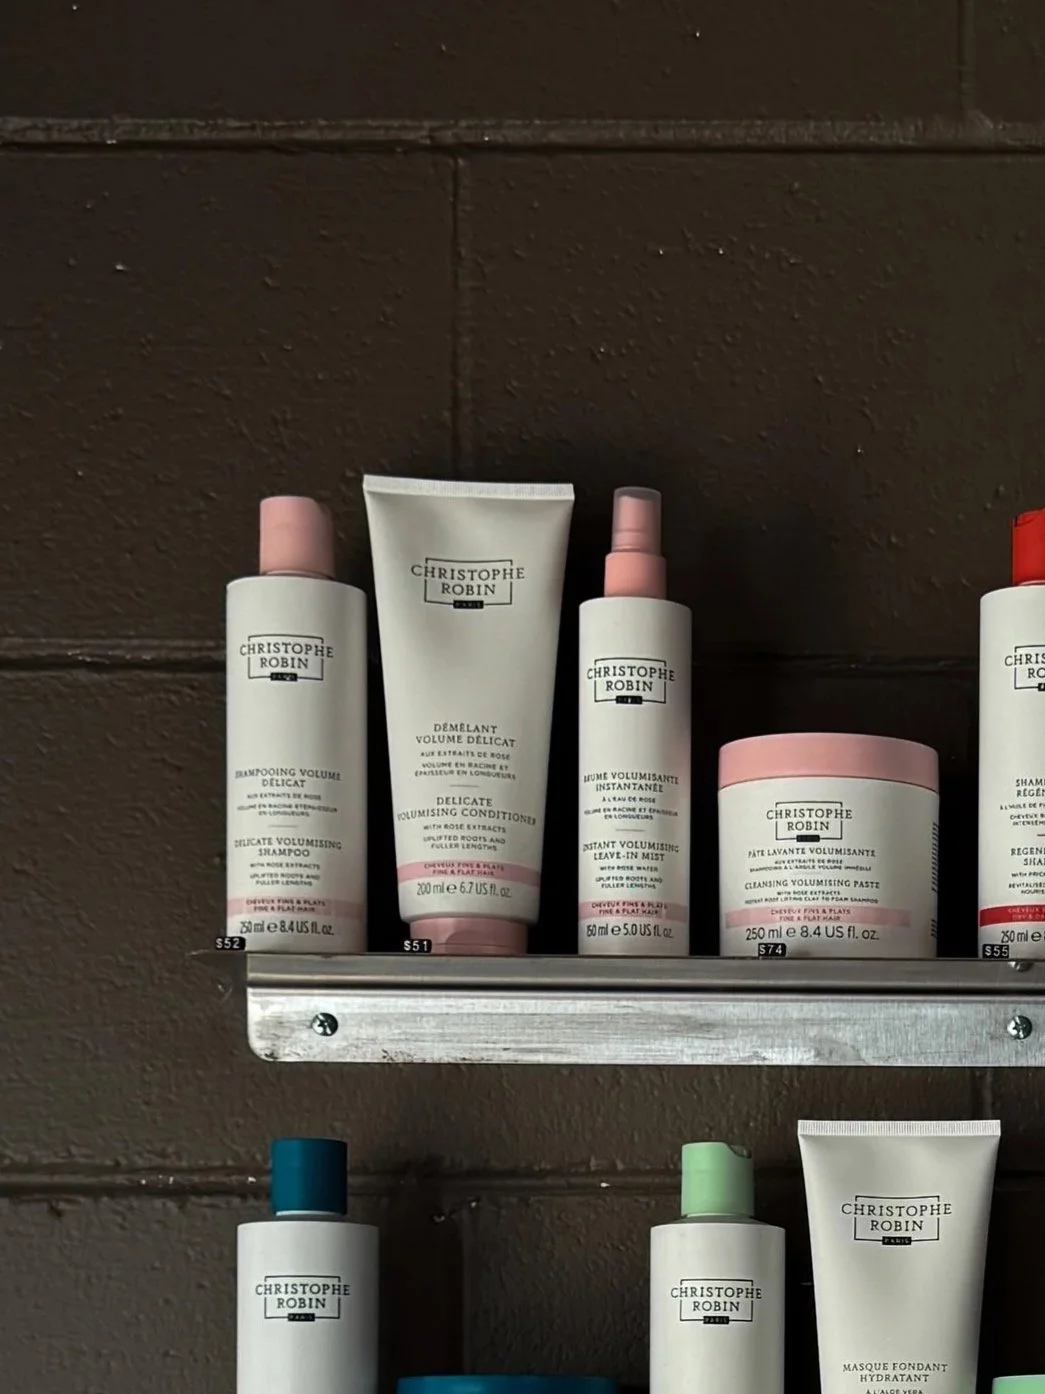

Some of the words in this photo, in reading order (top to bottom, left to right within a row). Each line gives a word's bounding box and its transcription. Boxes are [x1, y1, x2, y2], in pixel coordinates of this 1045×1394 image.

[410, 564, 526, 580] CHRISTOPHE
[441, 582, 496, 596] ROBIN
[239, 643, 334, 658] CHRISTOPHE
[260, 658, 309, 669] ROBIN
[587, 665, 675, 681] CHRISTOPHE
[606, 681, 653, 692] ROBIN
[416, 735, 463, 744] VOLUME
[437, 797, 492, 807] DELICATE
[766, 809, 853, 820] CHRISTOPHE
[787, 822, 829, 831] ROBIN
[746, 927, 765, 940] 250
[768, 926, 782, 938] ml
[800, 925, 821, 938] 8.4
[825, 926, 844, 938] US
[848, 926, 858, 939] fl.
[862, 930, 879, 940] oz.
[404, 941, 428, 951] $51
[760, 944, 783, 955] $74
[984, 945, 1008, 957] $55
[841, 1203, 953, 1216] CHRISTOPHE
[870, 1219, 924, 1232] ROBIN
[255, 1283, 351, 1296] CHRISTOPHE
[670, 1287, 762, 1300] CHRISTOPHE
[277, 1298, 326, 1309] ROBIN
[693, 1301, 740, 1312] ROBIN
[843, 1363, 888, 1373] MASQUE
[893, 1363, 947, 1372] FONDANT
[860, 1374, 929, 1382] HYDRATANT
